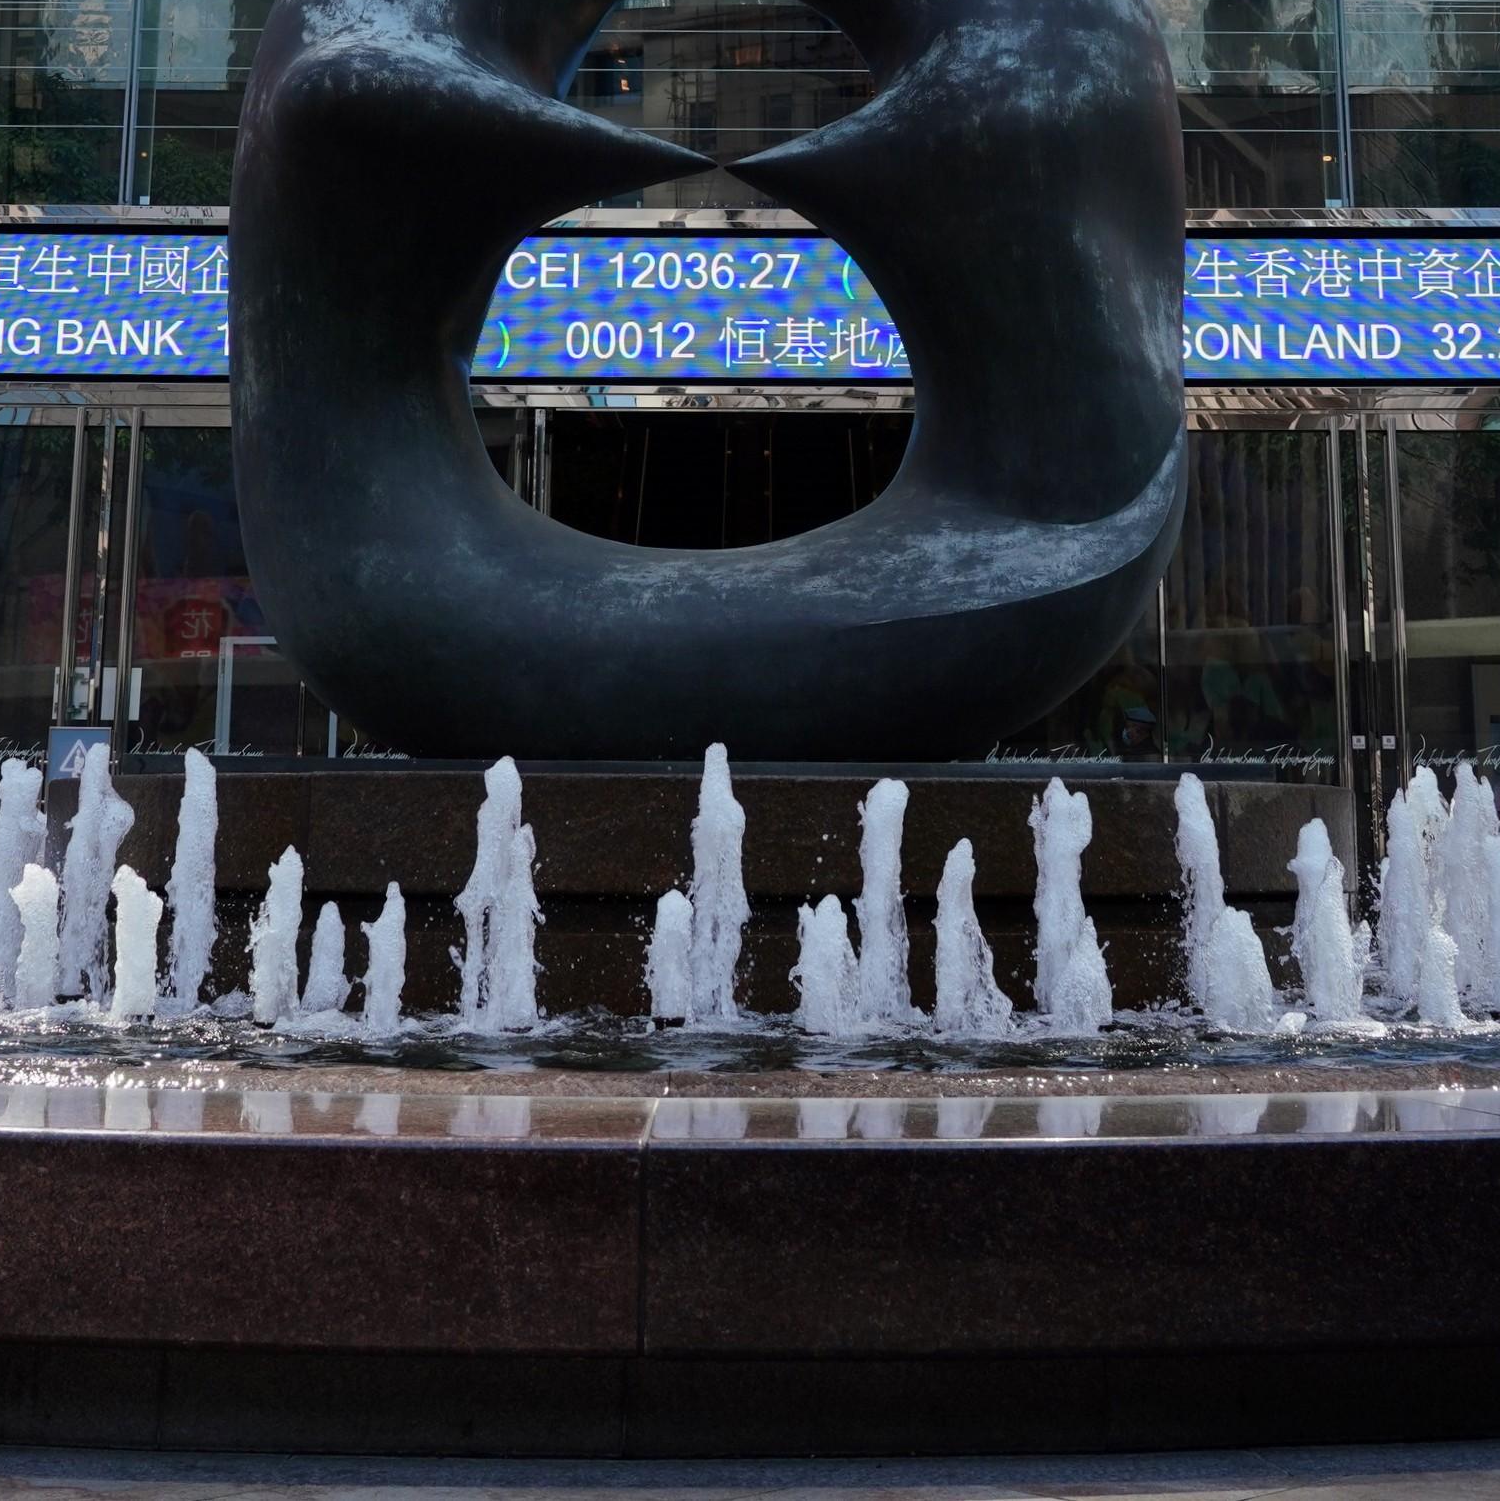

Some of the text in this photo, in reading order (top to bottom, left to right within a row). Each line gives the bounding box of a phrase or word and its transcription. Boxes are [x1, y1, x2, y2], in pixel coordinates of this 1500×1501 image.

[505, 251, 581, 290] CEI
[608, 252, 802, 291] 12036.27
[56, 319, 186, 357] BANK
[565, 321, 698, 361] 00012
[1278, 324, 1404, 361] LAND
